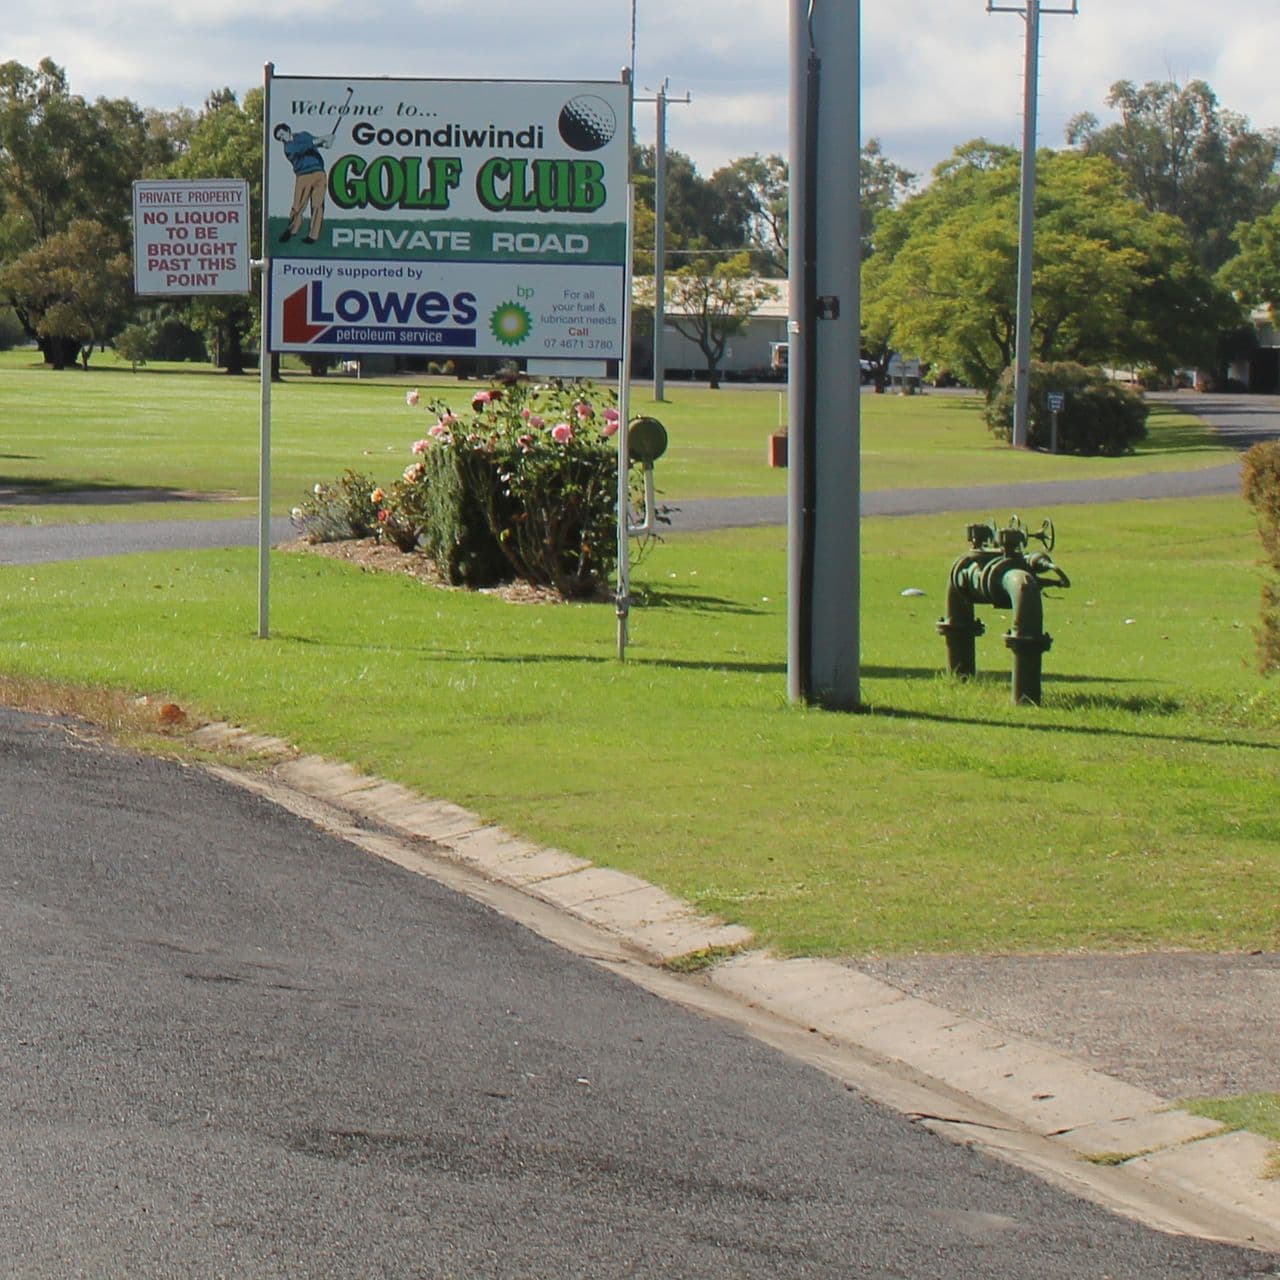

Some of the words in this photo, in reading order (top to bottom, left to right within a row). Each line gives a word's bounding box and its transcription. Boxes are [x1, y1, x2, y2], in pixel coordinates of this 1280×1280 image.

[291, 100, 383, 116] Welcome
[352, 122, 544, 148] Goondiwindi
[328, 154, 462, 210] GOLF
[476, 156, 607, 212] CLUB
[139, 191, 183, 203] PRIVATE
[188, 190, 242, 203] PROPERTY
[143, 212, 169, 224] NO
[174, 211, 239, 224] LIQUOR
[166, 227, 189, 240] TO
[195, 227, 218, 239] BE
[332, 228, 471, 251] PRIVATE
[492, 231, 589, 254] ROAD
[147, 242, 237, 256] BROUGHT
[148, 258, 191, 271] PAST
[197, 257, 237, 270] THIS
[283, 264, 333, 278] Proudly
[337, 266, 403, 280] supported
[407, 267, 423, 280] by
[166, 273, 218, 287] POINT
[516, 284, 535, 300] bp
[563, 289, 581, 299] For
[583, 290, 595, 300] all
[552, 304, 574, 313] your
[577, 303, 595, 312] fuel
[336, 328, 396, 343] petroleum
[400, 330, 443, 343] service
[568, 327, 589, 336] Call
[544, 339, 556, 348] 07
